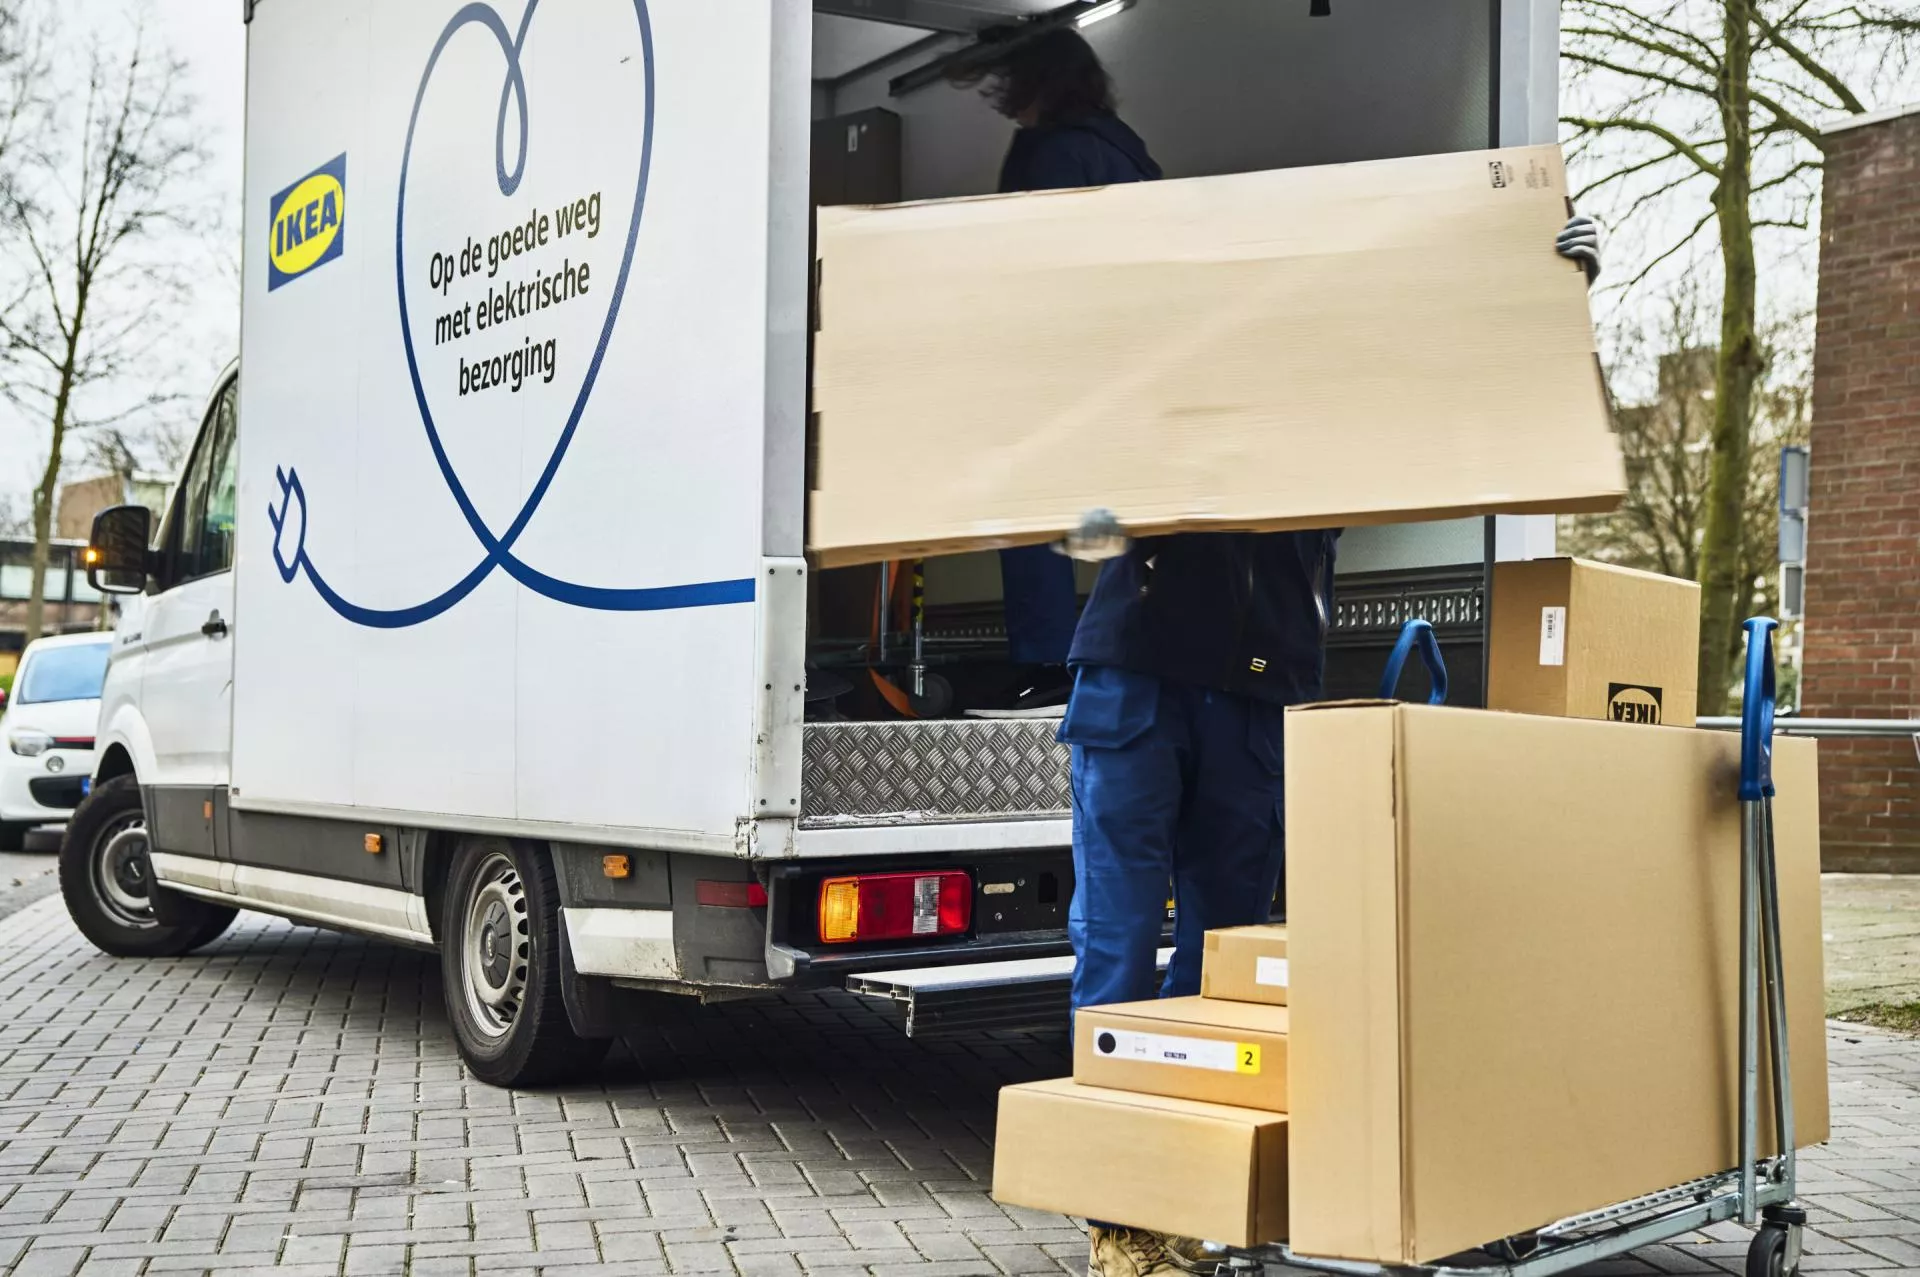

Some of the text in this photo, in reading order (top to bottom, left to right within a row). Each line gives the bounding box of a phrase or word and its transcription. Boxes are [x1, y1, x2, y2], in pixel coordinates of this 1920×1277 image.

[276, 189, 338, 258] IKEA
[430, 191, 601, 296] Op de goede weg
[435, 258, 590, 346] met elektrische
[459, 336, 557, 396] bezorging
[1612, 701, 1657, 725] IKEA
[1244, 1051, 1254, 1066] 2
